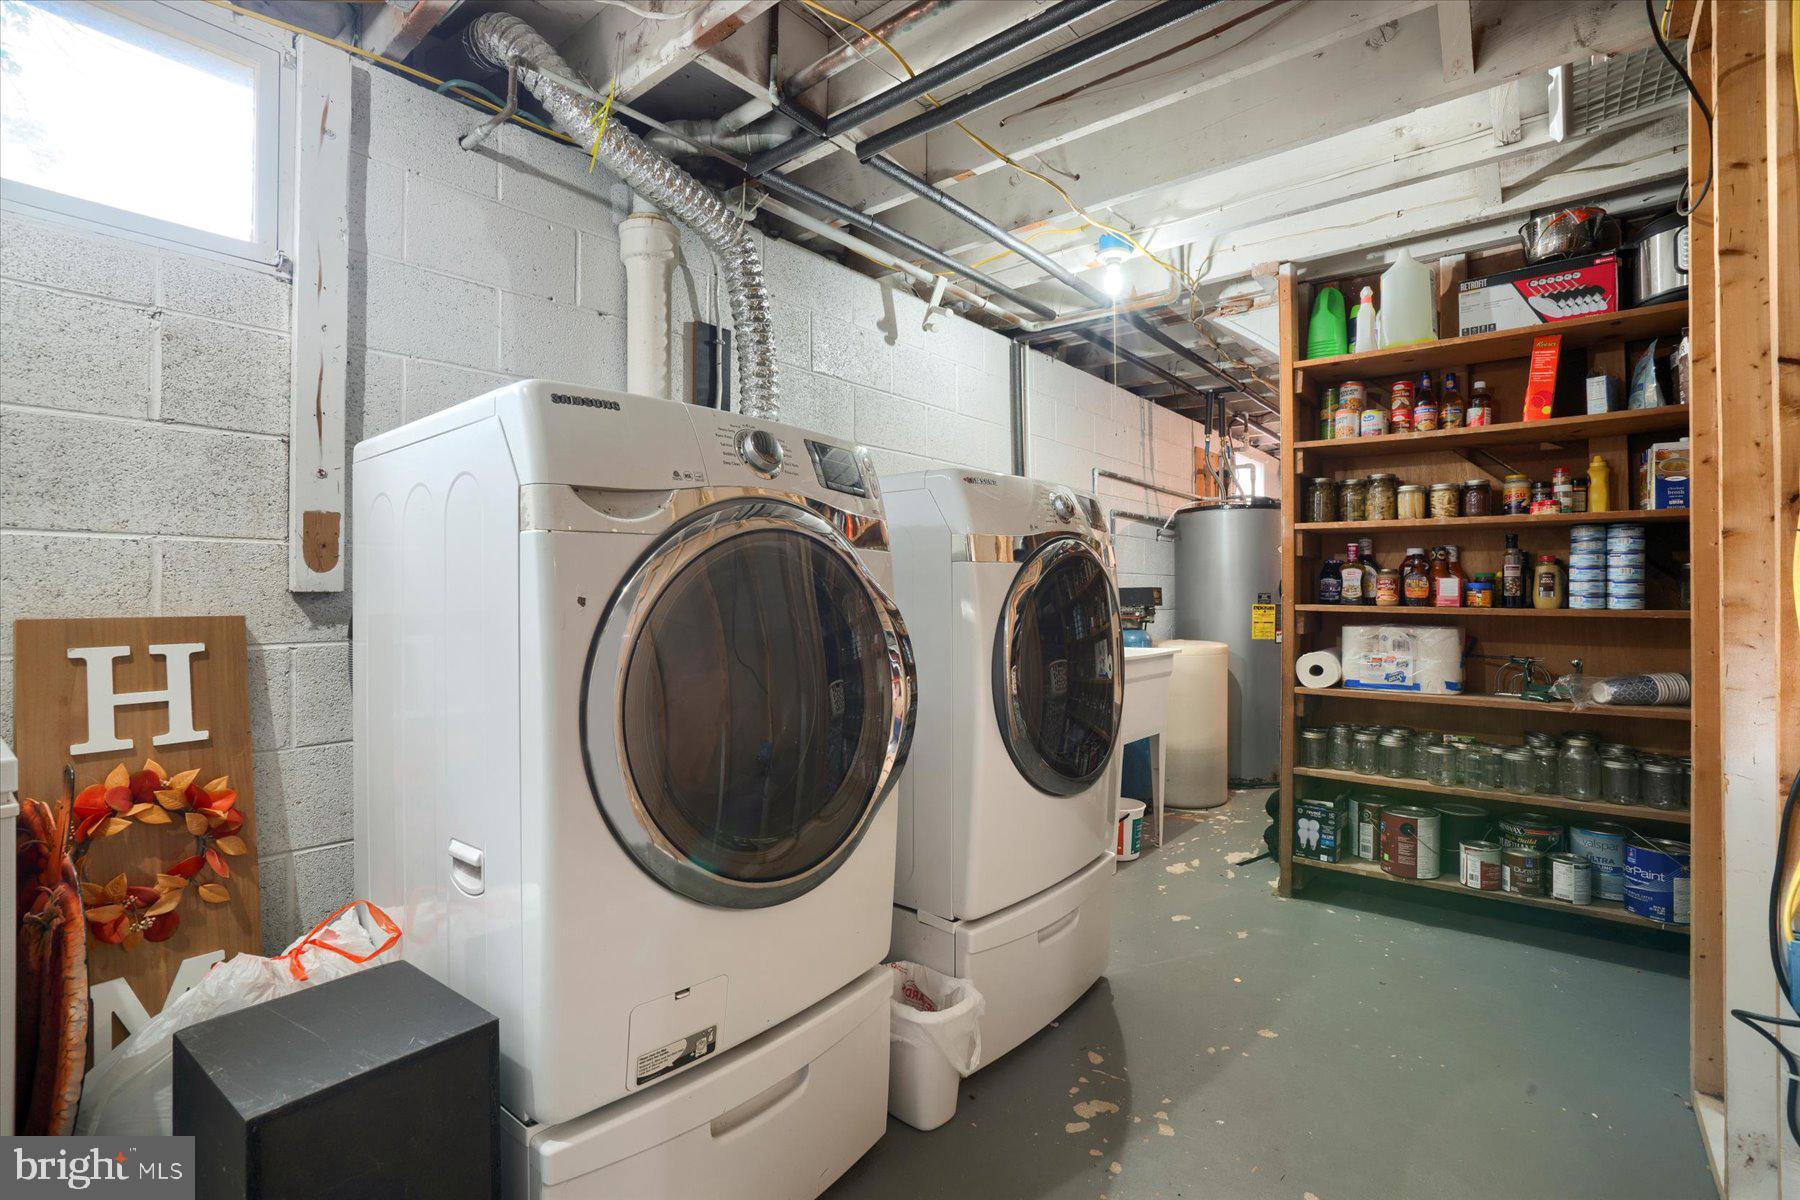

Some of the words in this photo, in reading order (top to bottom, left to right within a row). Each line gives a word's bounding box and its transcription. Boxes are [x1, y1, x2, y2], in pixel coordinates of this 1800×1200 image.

[1460, 278, 1488, 292] RETROFIT
[551, 393, 621, 411] SAMSUNG
[67, 643, 209, 755] H
[1583, 840, 1620, 851] valspar
